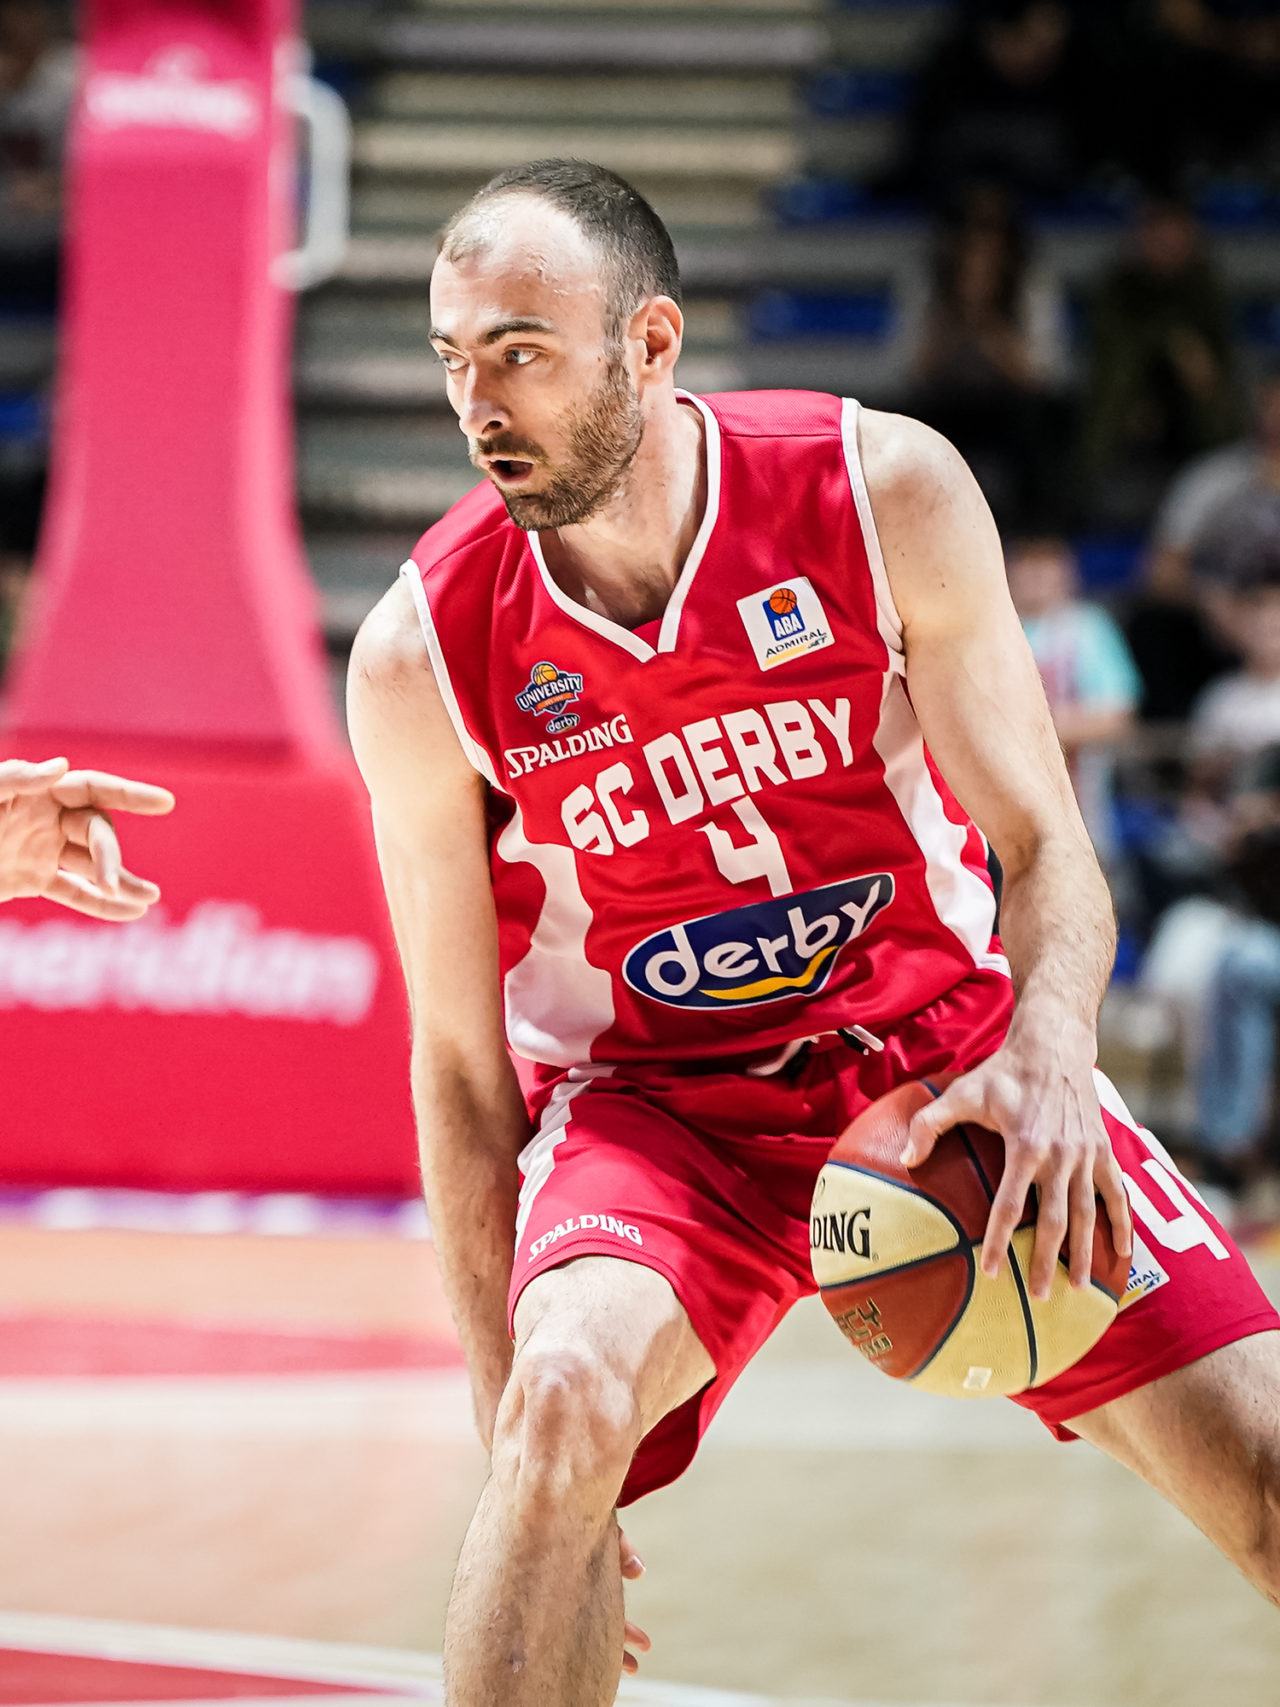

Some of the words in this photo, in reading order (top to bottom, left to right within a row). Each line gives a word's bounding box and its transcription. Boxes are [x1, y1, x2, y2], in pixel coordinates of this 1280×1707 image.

[766, 629, 827, 658] ADMIRAL
[773, 613, 802, 638] ABA
[518, 677, 581, 709] UNIVERSITY
[504, 713, 634, 779] SPALDING
[548, 715, 579, 732] derby
[561, 761, 650, 855] SC
[642, 698, 851, 825] DERBY
[695, 795, 793, 898] 4
[645, 880, 881, 997] derby
[810, 1207, 870, 1259] DING
[1122, 1158, 1231, 1261] 4
[528, 1214, 643, 1263] SPALDING
